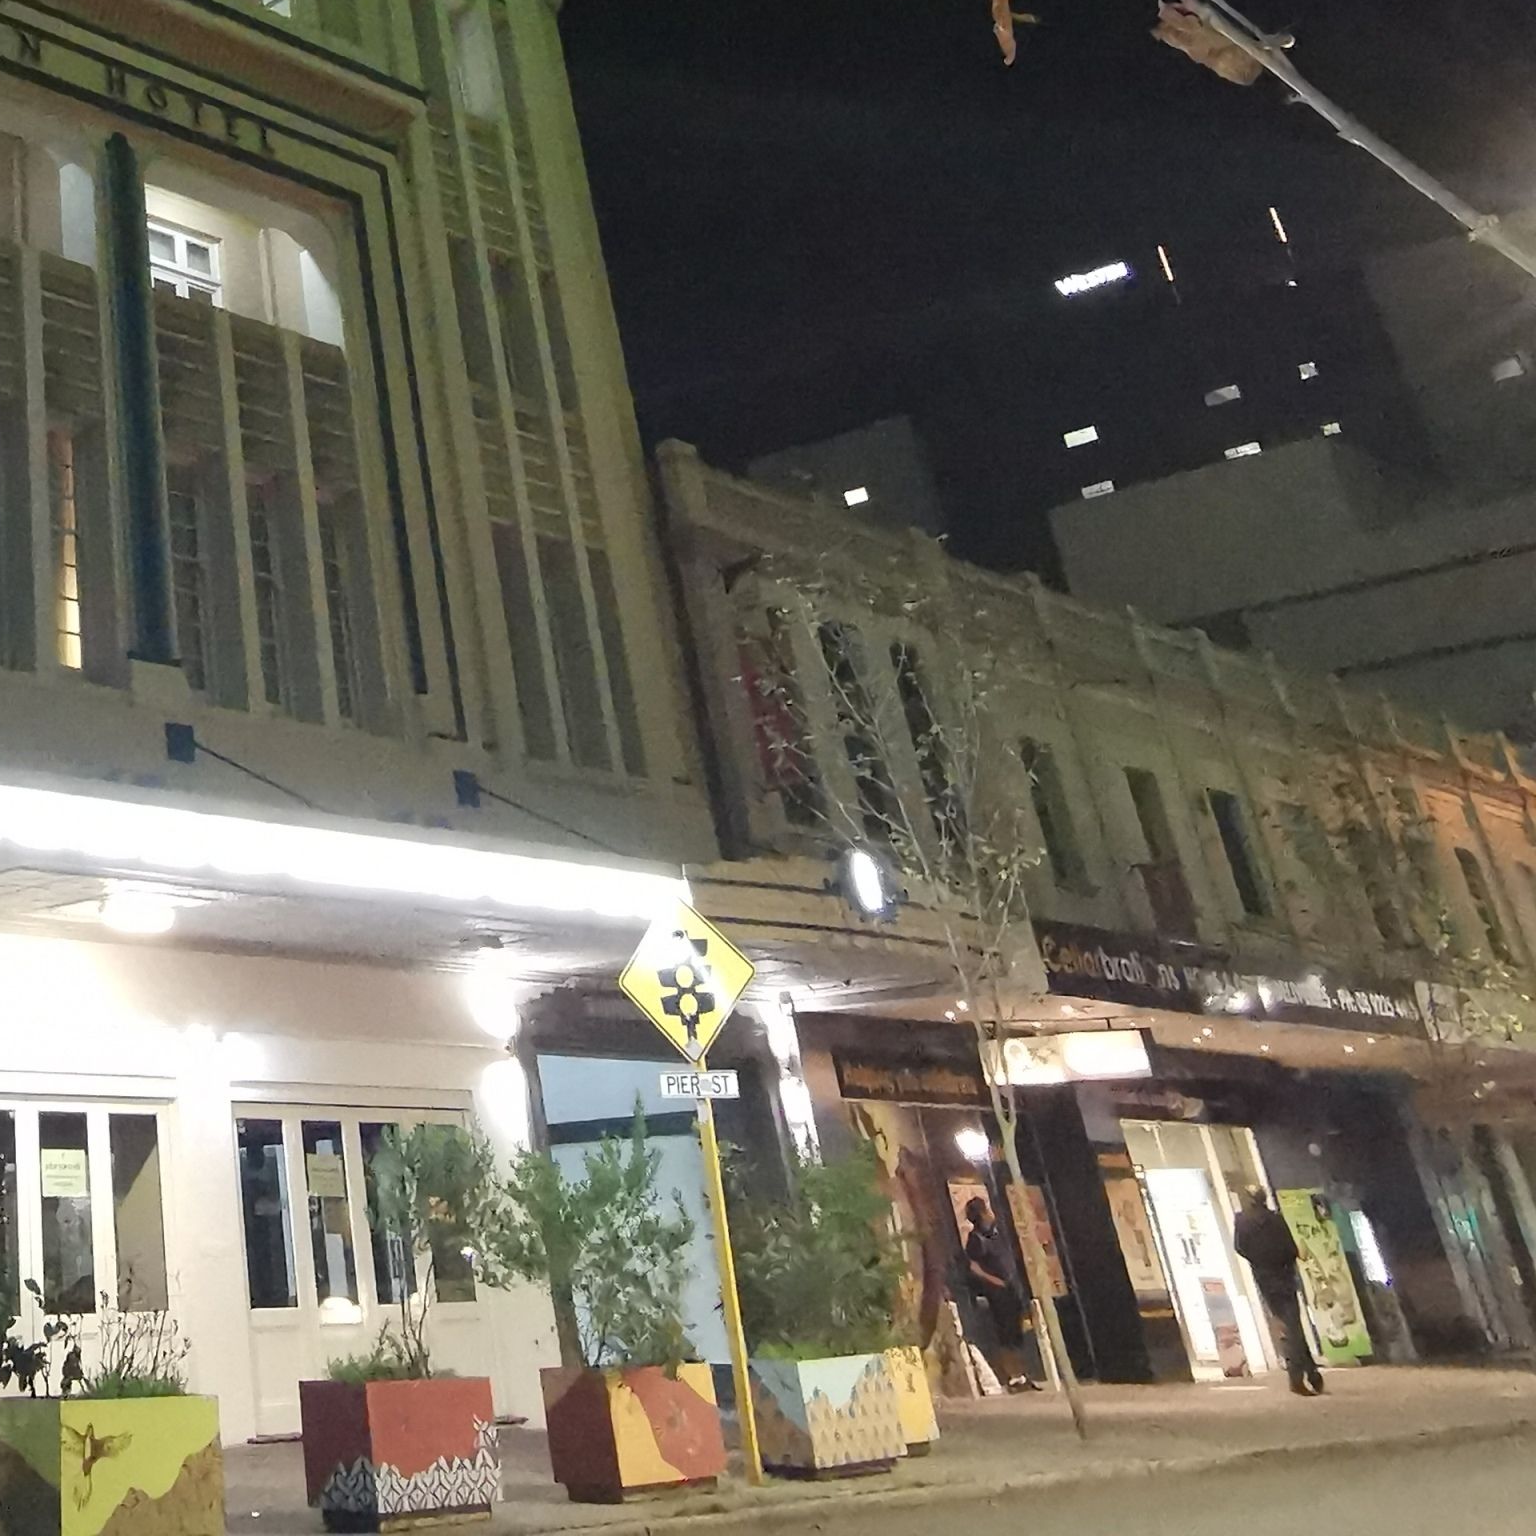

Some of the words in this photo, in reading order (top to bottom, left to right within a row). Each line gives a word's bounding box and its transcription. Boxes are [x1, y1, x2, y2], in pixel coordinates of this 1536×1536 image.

[106, 61, 276, 155] HOTEL
[666, 1074, 701, 1096] PIER
[711, 1075, 731, 1095] ST
